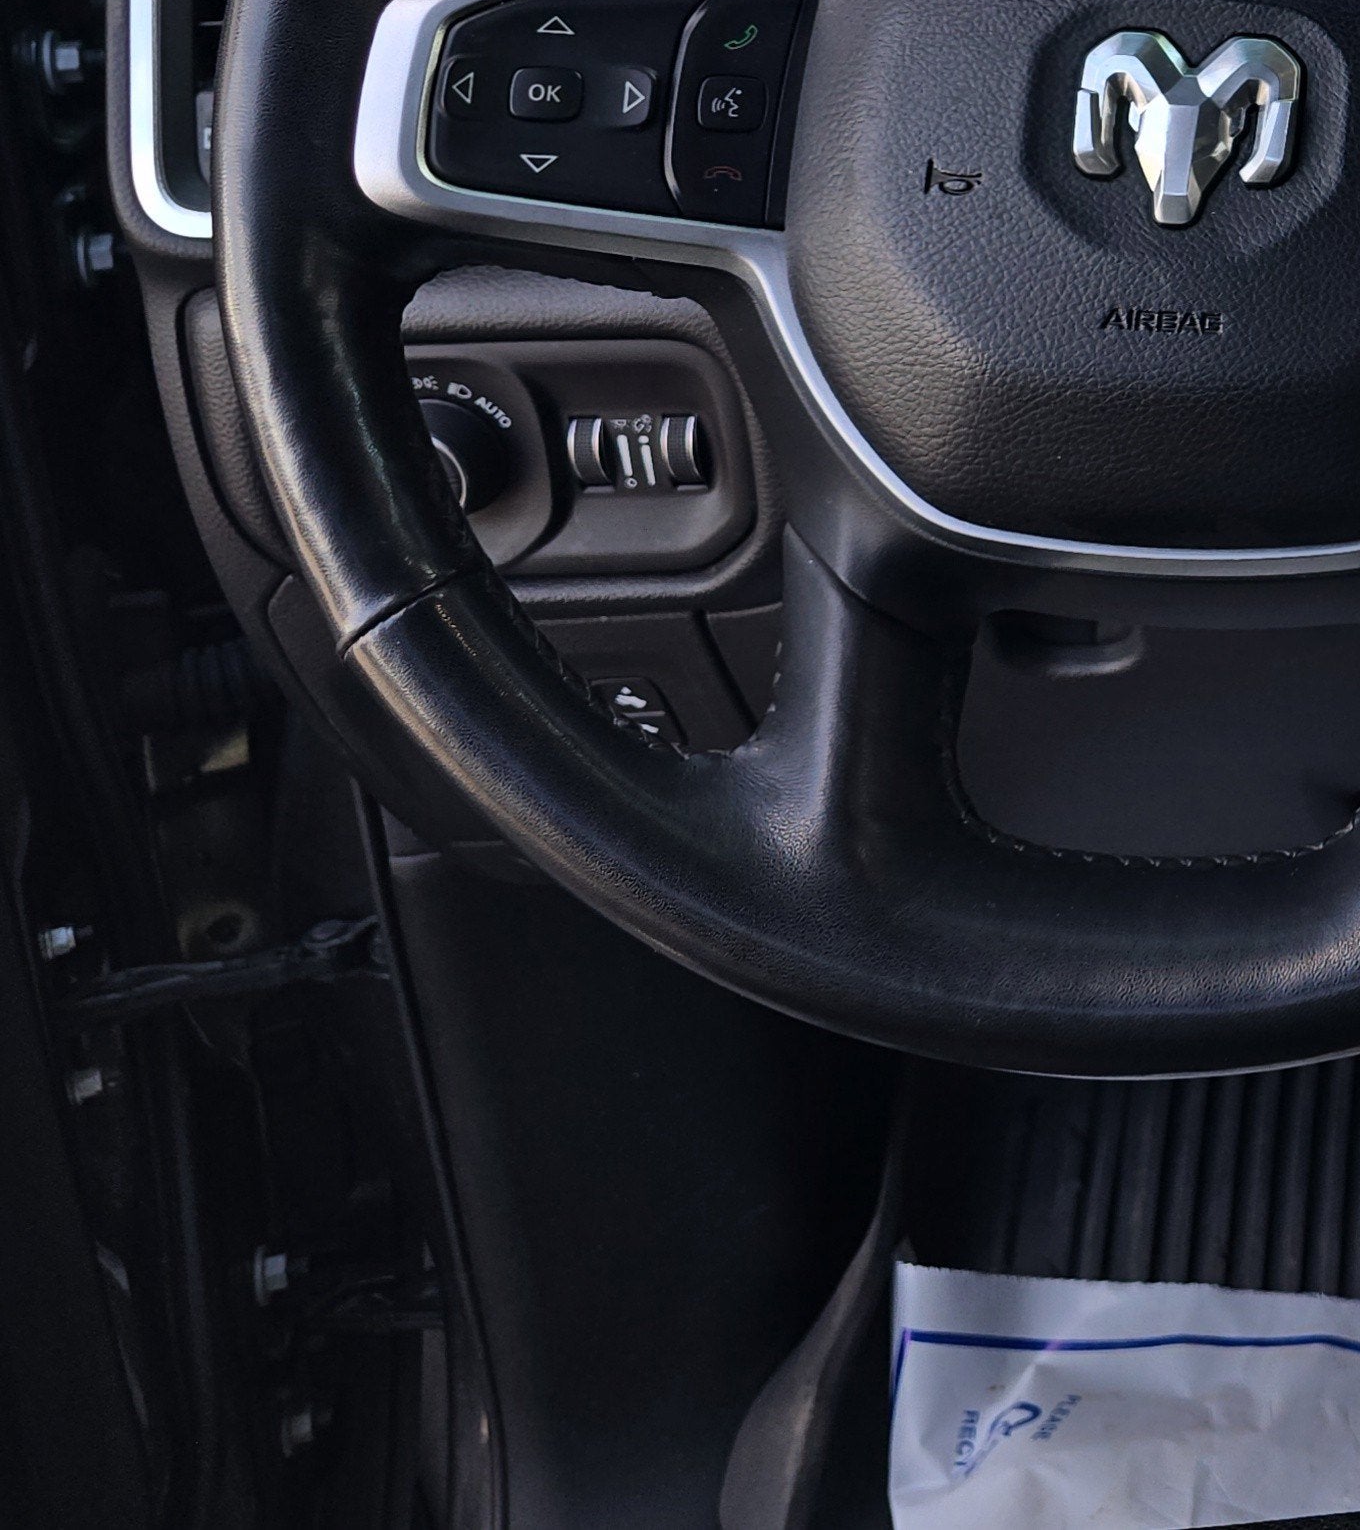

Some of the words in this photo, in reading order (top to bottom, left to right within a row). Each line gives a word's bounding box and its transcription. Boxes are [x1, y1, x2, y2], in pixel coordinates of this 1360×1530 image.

[528, 83, 561, 103] OK
[1101, 306, 1224, 335] AIRBAG
[474, 396, 512, 428] AUTO
